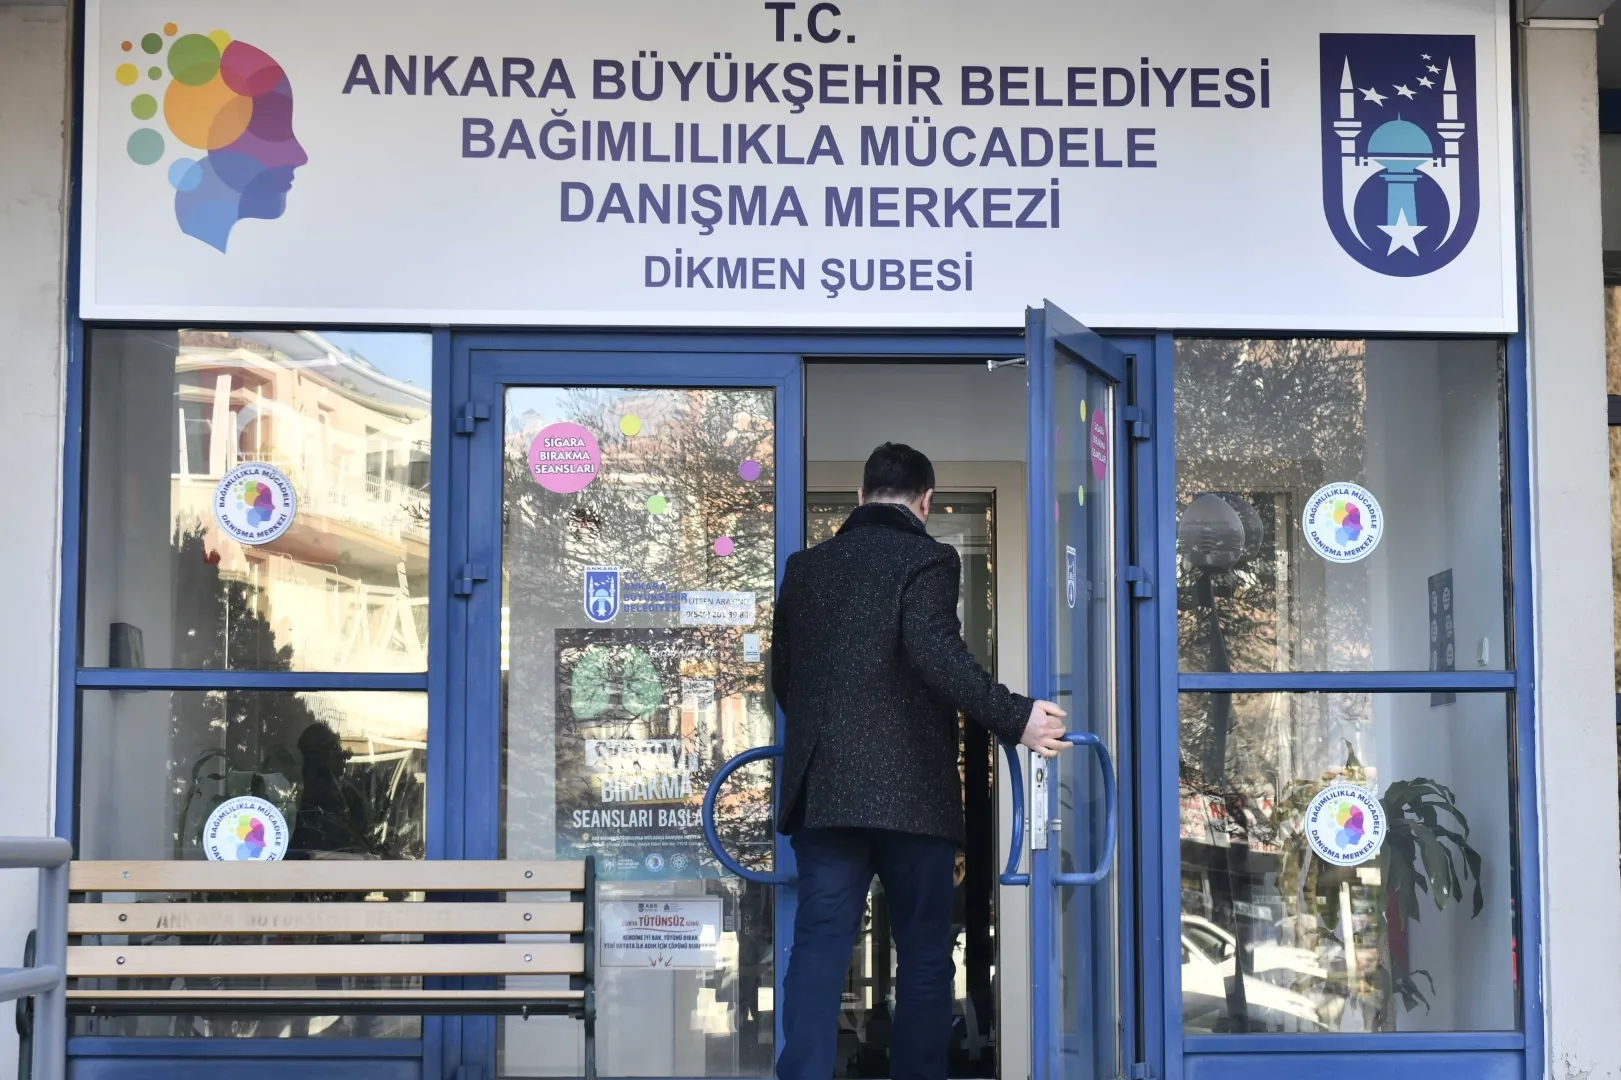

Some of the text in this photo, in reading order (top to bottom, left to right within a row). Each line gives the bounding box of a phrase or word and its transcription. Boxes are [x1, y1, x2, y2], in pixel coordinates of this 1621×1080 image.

[764, 2, 856, 43] T.C.
[342, 51, 1270, 114] ANKARA BÜYÜKŞEHİR BELEDİYESİ
[461, 108, 1158, 168] BAĞIMLILIKLA MÜCADELE
[561, 178, 1060, 236] DANIŞMA MERKEZİ
[645, 249, 973, 299] DİKMEN ŞUBESİ
[539, 450, 591, 461] BIRAKMA
[544, 435, 586, 448] SİGARA
[535, 464, 595, 474] SEANSLARI
[219, 469, 260, 508] BAĞIMLILIKLA
[261, 470, 290, 508] MÜCADELE
[221, 513, 287, 538] DANIŞMA MERKEZİ
[1309, 489, 1378, 529] BAĞIMLILIKLA MÜCADELE
[1310, 531, 1374, 557] DANIŞMA MERKEZİ
[623, 582, 666, 591] ANKARA
[210, 803, 255, 839] BAĞIMLILIKLA
[257, 806, 282, 846] MÜCADELE
[573, 809, 653, 829] SEANSLARI
[1311, 790, 1380, 836] BAĞIMLILIKLA MÜCADELE
[1311, 829, 1340, 859] DANIŞMA
[1342, 840, 1375, 860] MERKEZİ
[638, 915, 685, 927] TÜTÜNSÜZ
